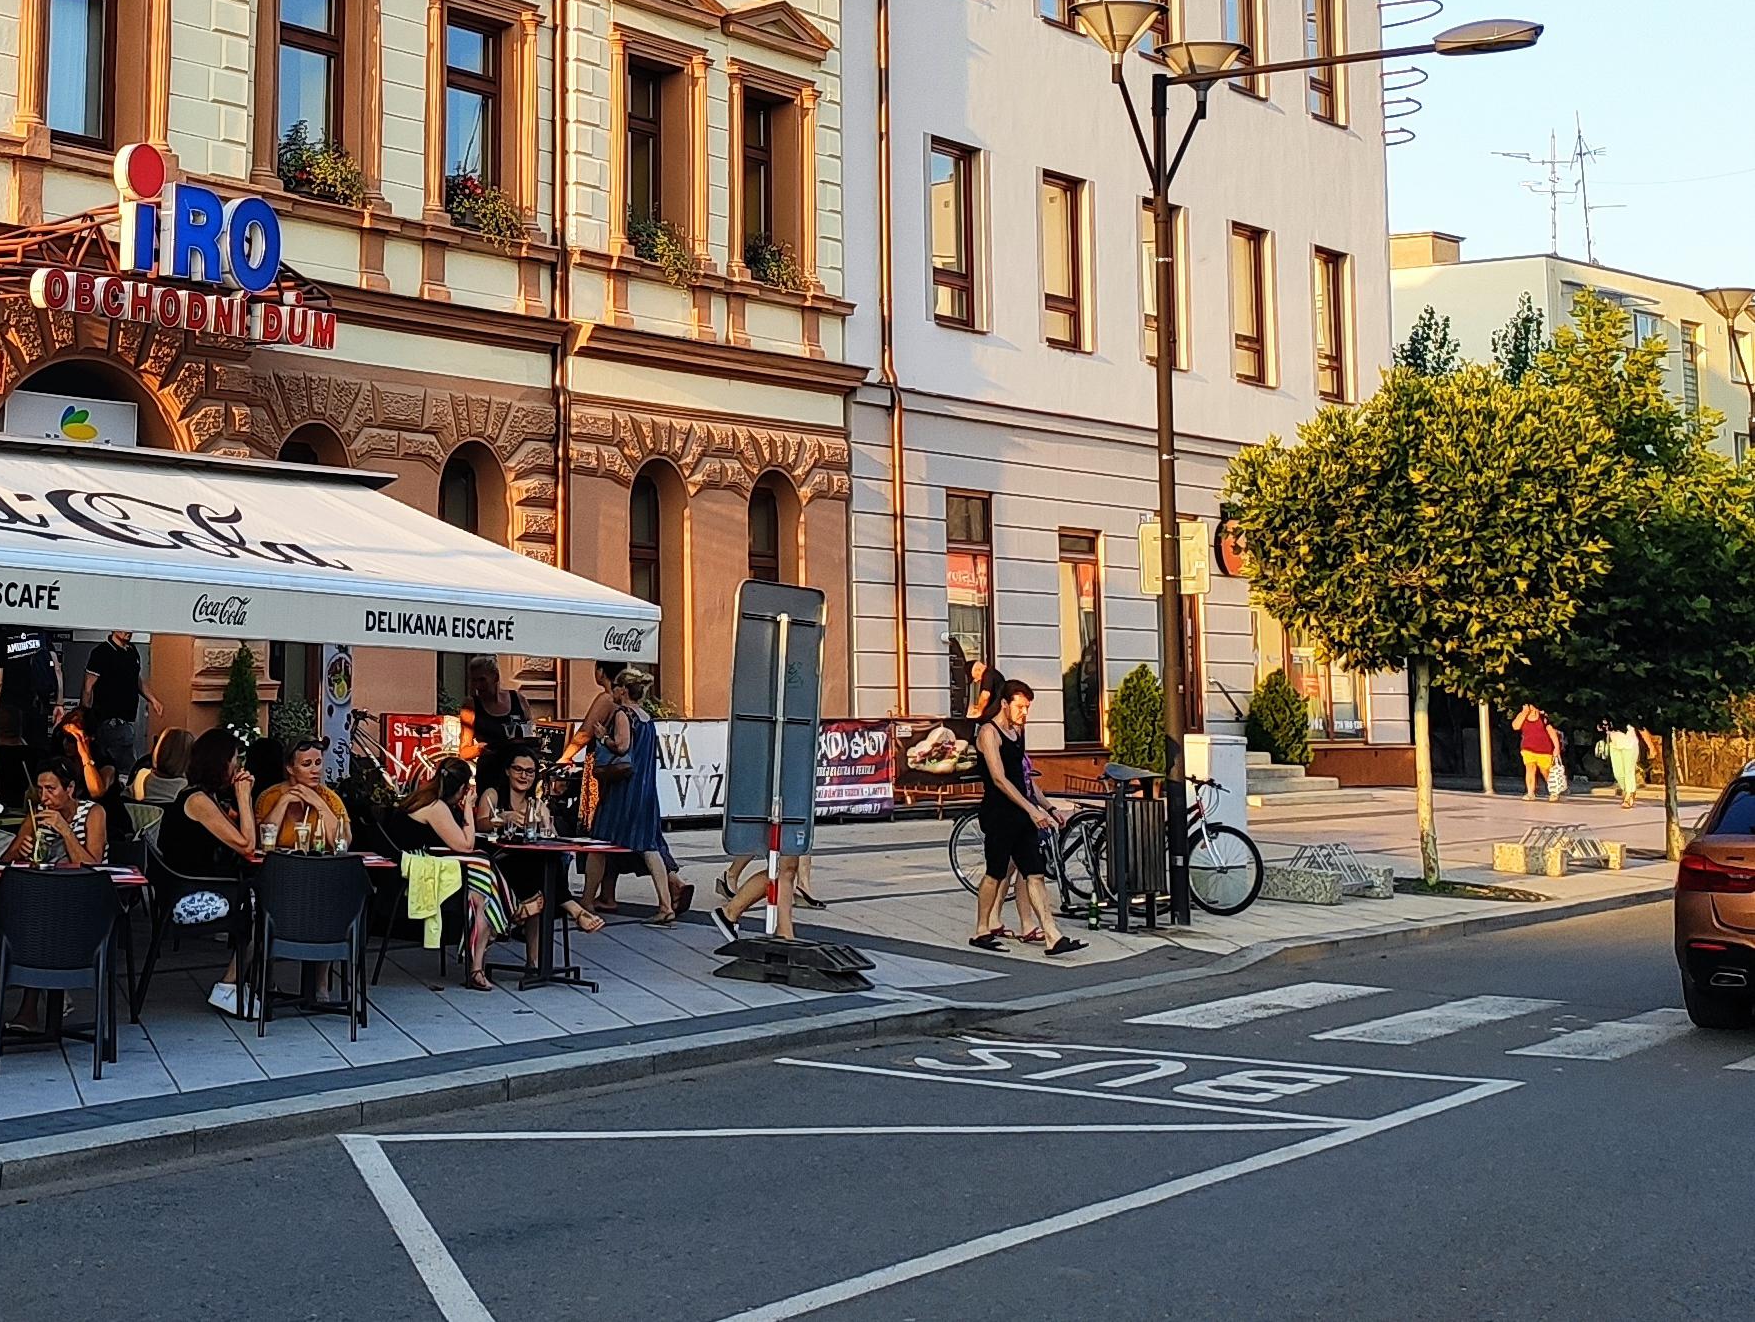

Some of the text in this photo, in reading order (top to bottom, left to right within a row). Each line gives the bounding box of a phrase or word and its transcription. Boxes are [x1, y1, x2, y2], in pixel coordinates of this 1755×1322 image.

[255, 291, 337, 351] DŮM
[192, 593, 252, 627] Coca-Cola
[364, 610, 515, 642] DELIKANA EISCAFÉ
[603, 625, 646, 654] Coca-Cola
[913, 1043, 1351, 1103] BUS
